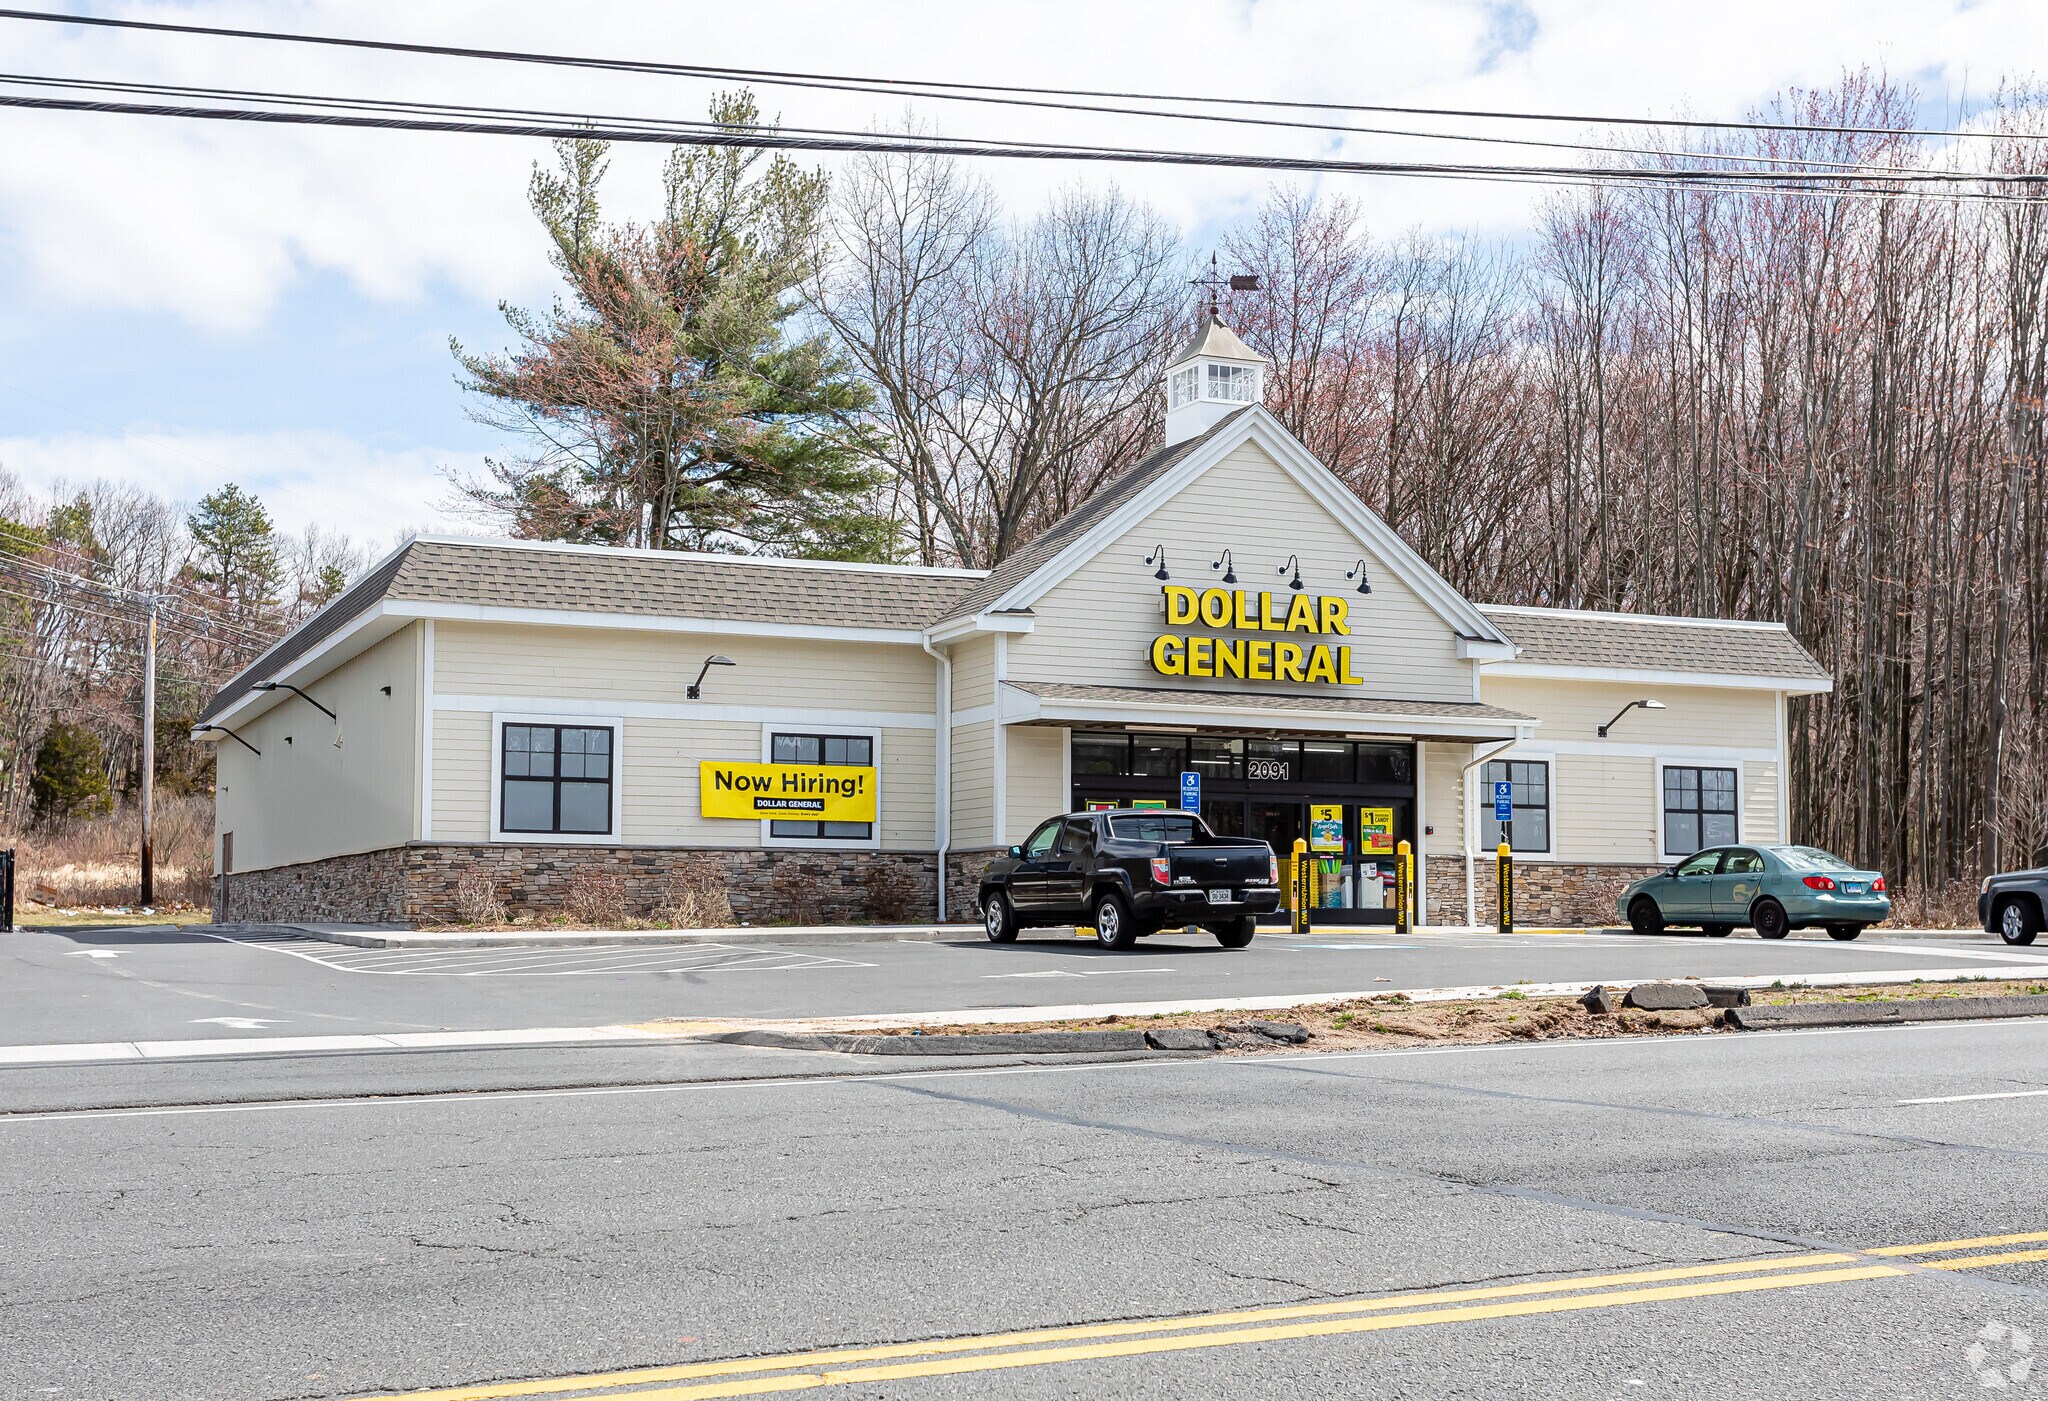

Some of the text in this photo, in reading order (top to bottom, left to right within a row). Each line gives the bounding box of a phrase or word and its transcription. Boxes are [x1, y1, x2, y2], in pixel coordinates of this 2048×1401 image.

[1162, 585, 1351, 636] DOLLAR
[1150, 634, 1364, 685] GENERAL
[1248, 761, 1289, 780] 2091
[715, 770, 864, 798] Now Hiring!
[757, 799, 822, 808] DOLLAR GENERAL
[1321, 809, 1332, 821] $5
[1364, 812, 1374, 824] $1
